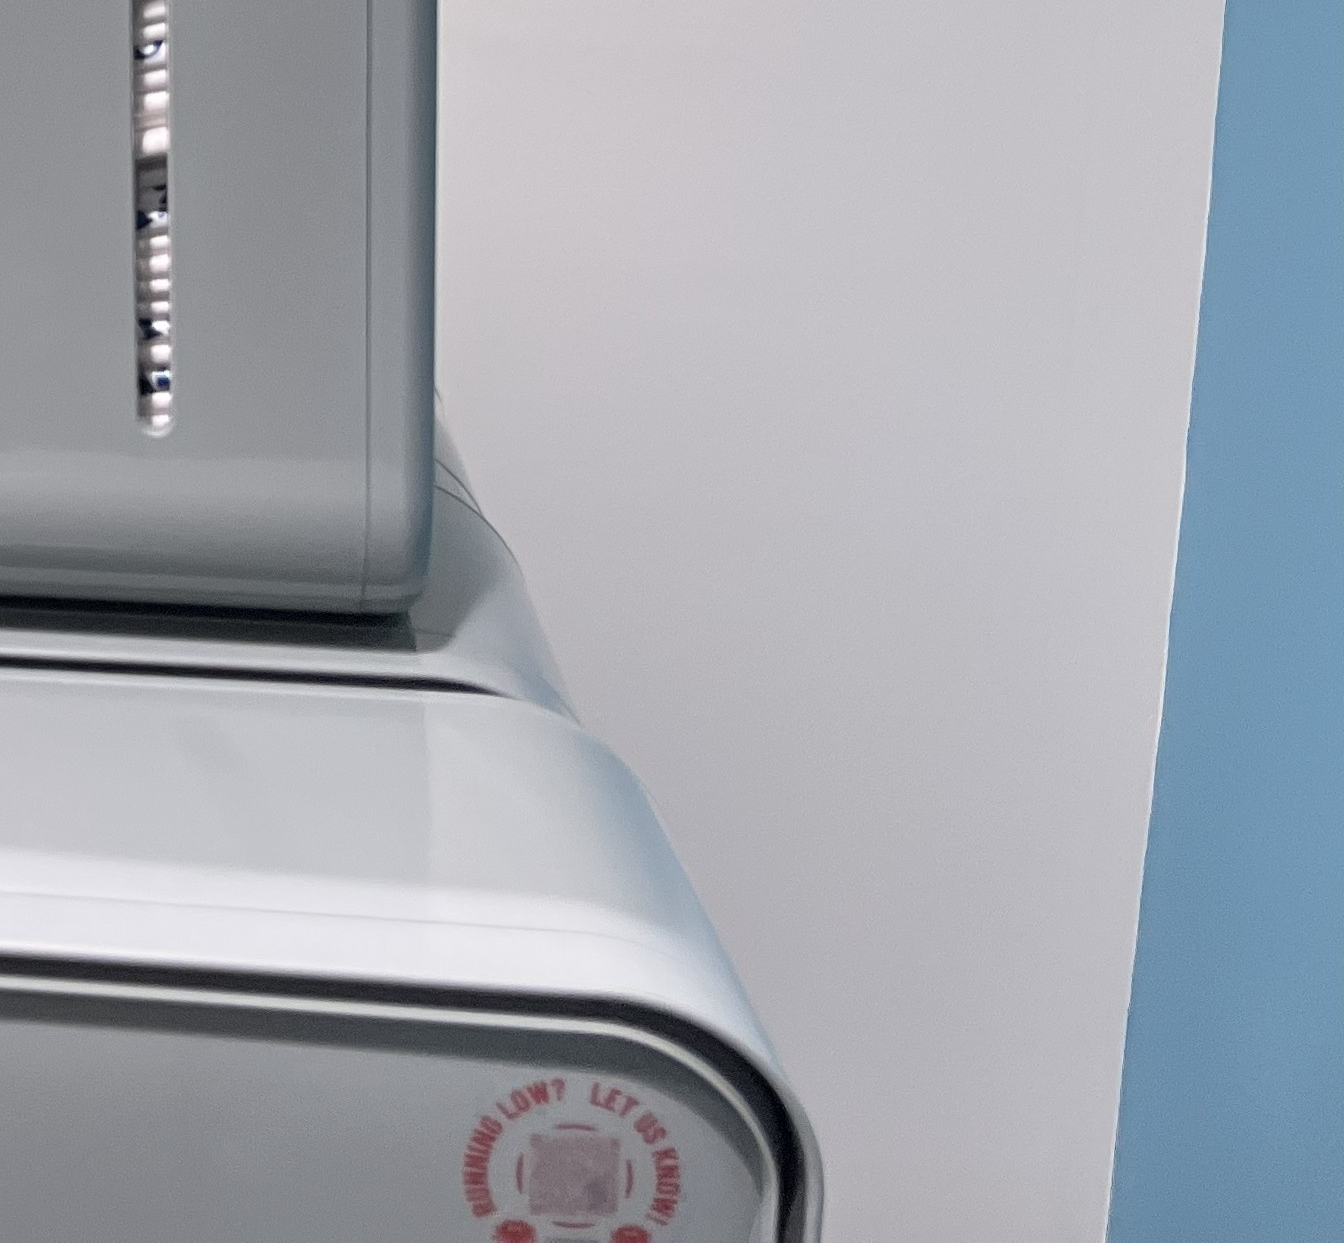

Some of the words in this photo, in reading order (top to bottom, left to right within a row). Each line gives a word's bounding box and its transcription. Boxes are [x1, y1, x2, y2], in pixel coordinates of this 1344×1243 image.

[590, 1082, 640, 1118] LET
[634, 1110, 668, 1145] US
[465, 1115, 503, 1218] RUNNING
[496, 1078, 566, 1120] LOW?
[645, 1147, 680, 1226] KNOW!
